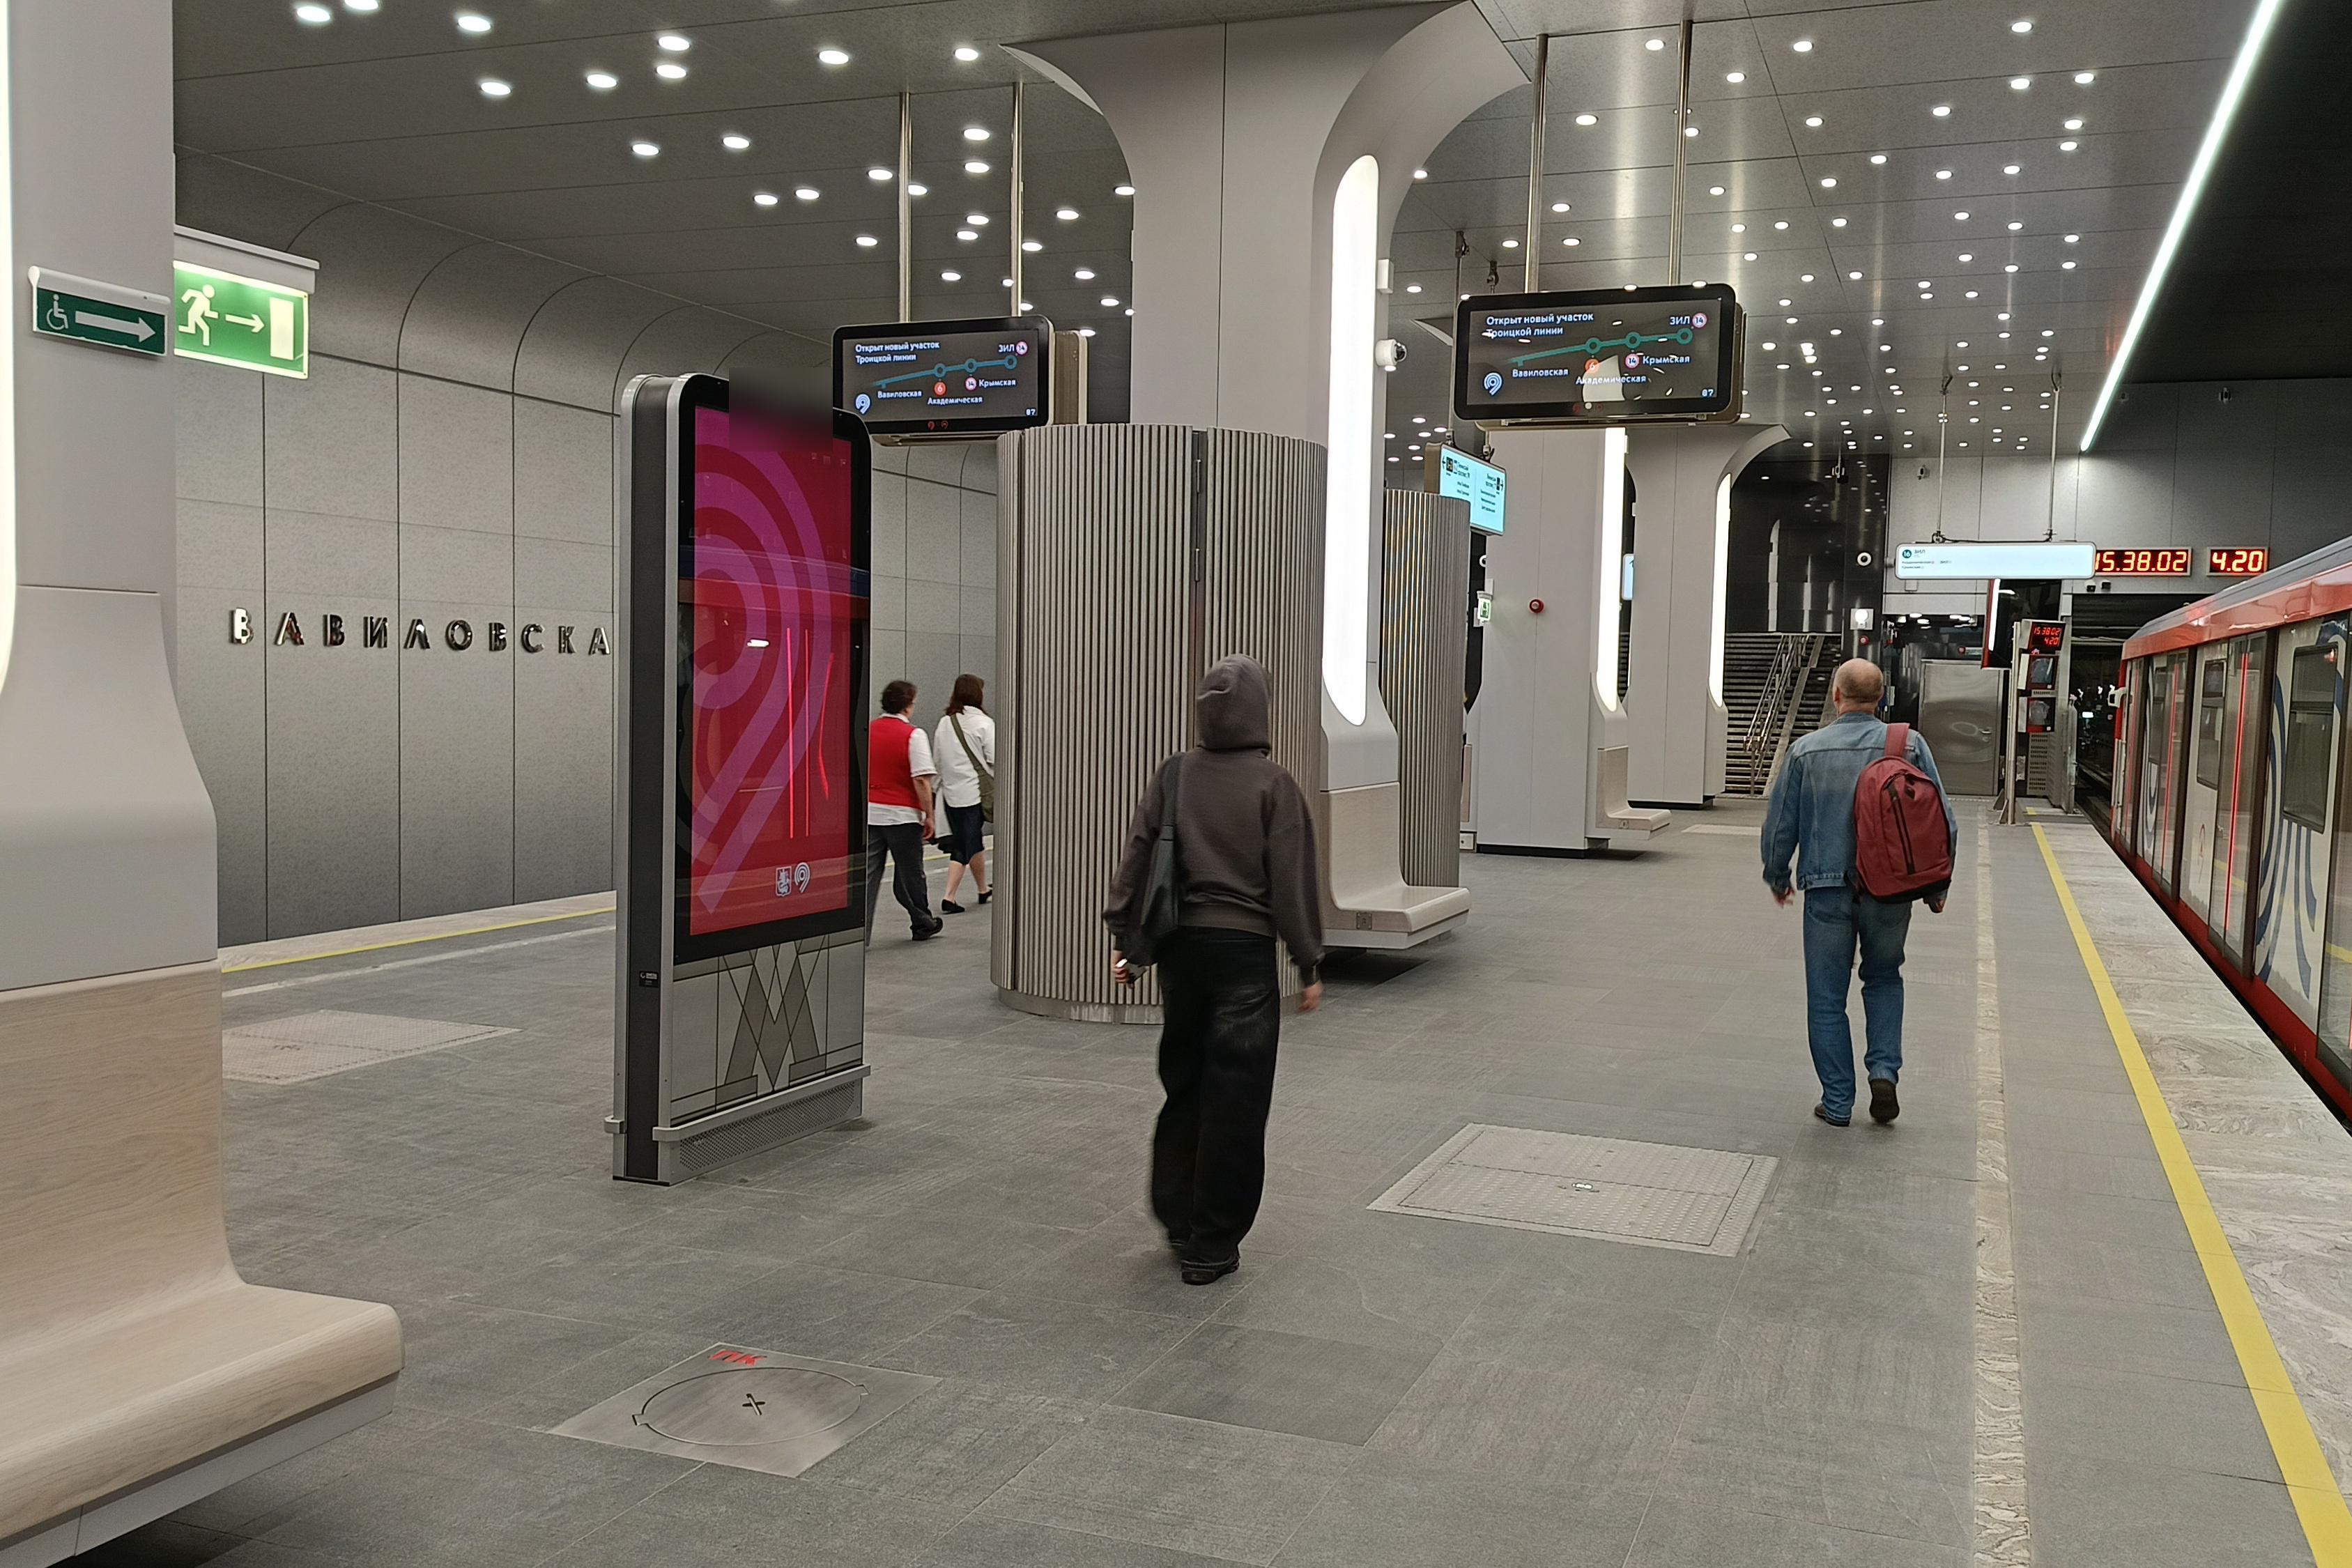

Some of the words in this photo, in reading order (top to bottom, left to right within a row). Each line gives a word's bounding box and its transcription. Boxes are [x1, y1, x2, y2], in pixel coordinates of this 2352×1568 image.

[1486, 316, 1522, 325] Открыт
[1523, 314, 1554, 323] новый
[1556, 314, 1594, 323] участок
[1670, 316, 1691, 325] ЗИЛ
[1533, 327, 1563, 336] линии
[855, 344, 884, 353] Открыт
[884, 341, 909, 351] новый
[910, 341, 940, 351] участок
[999, 344, 1015, 353] ЗИЛ
[855, 354, 892, 364] Троицкой
[1643, 355, 1690, 366] Крымская
[1512, 369, 1569, 378] Вавиловская
[978, 379, 1016, 388] Крымская
[1576, 376, 1646, 385] Академическая
[877, 390, 922, 399] Вавиловская
[928, 397, 983, 405] Академическая
[2095, 551, 2187, 571] 15.38.02
[2212, 551, 2263, 572] 4.20
[230, 607, 611, 656] ВАВИЛОВСКА
